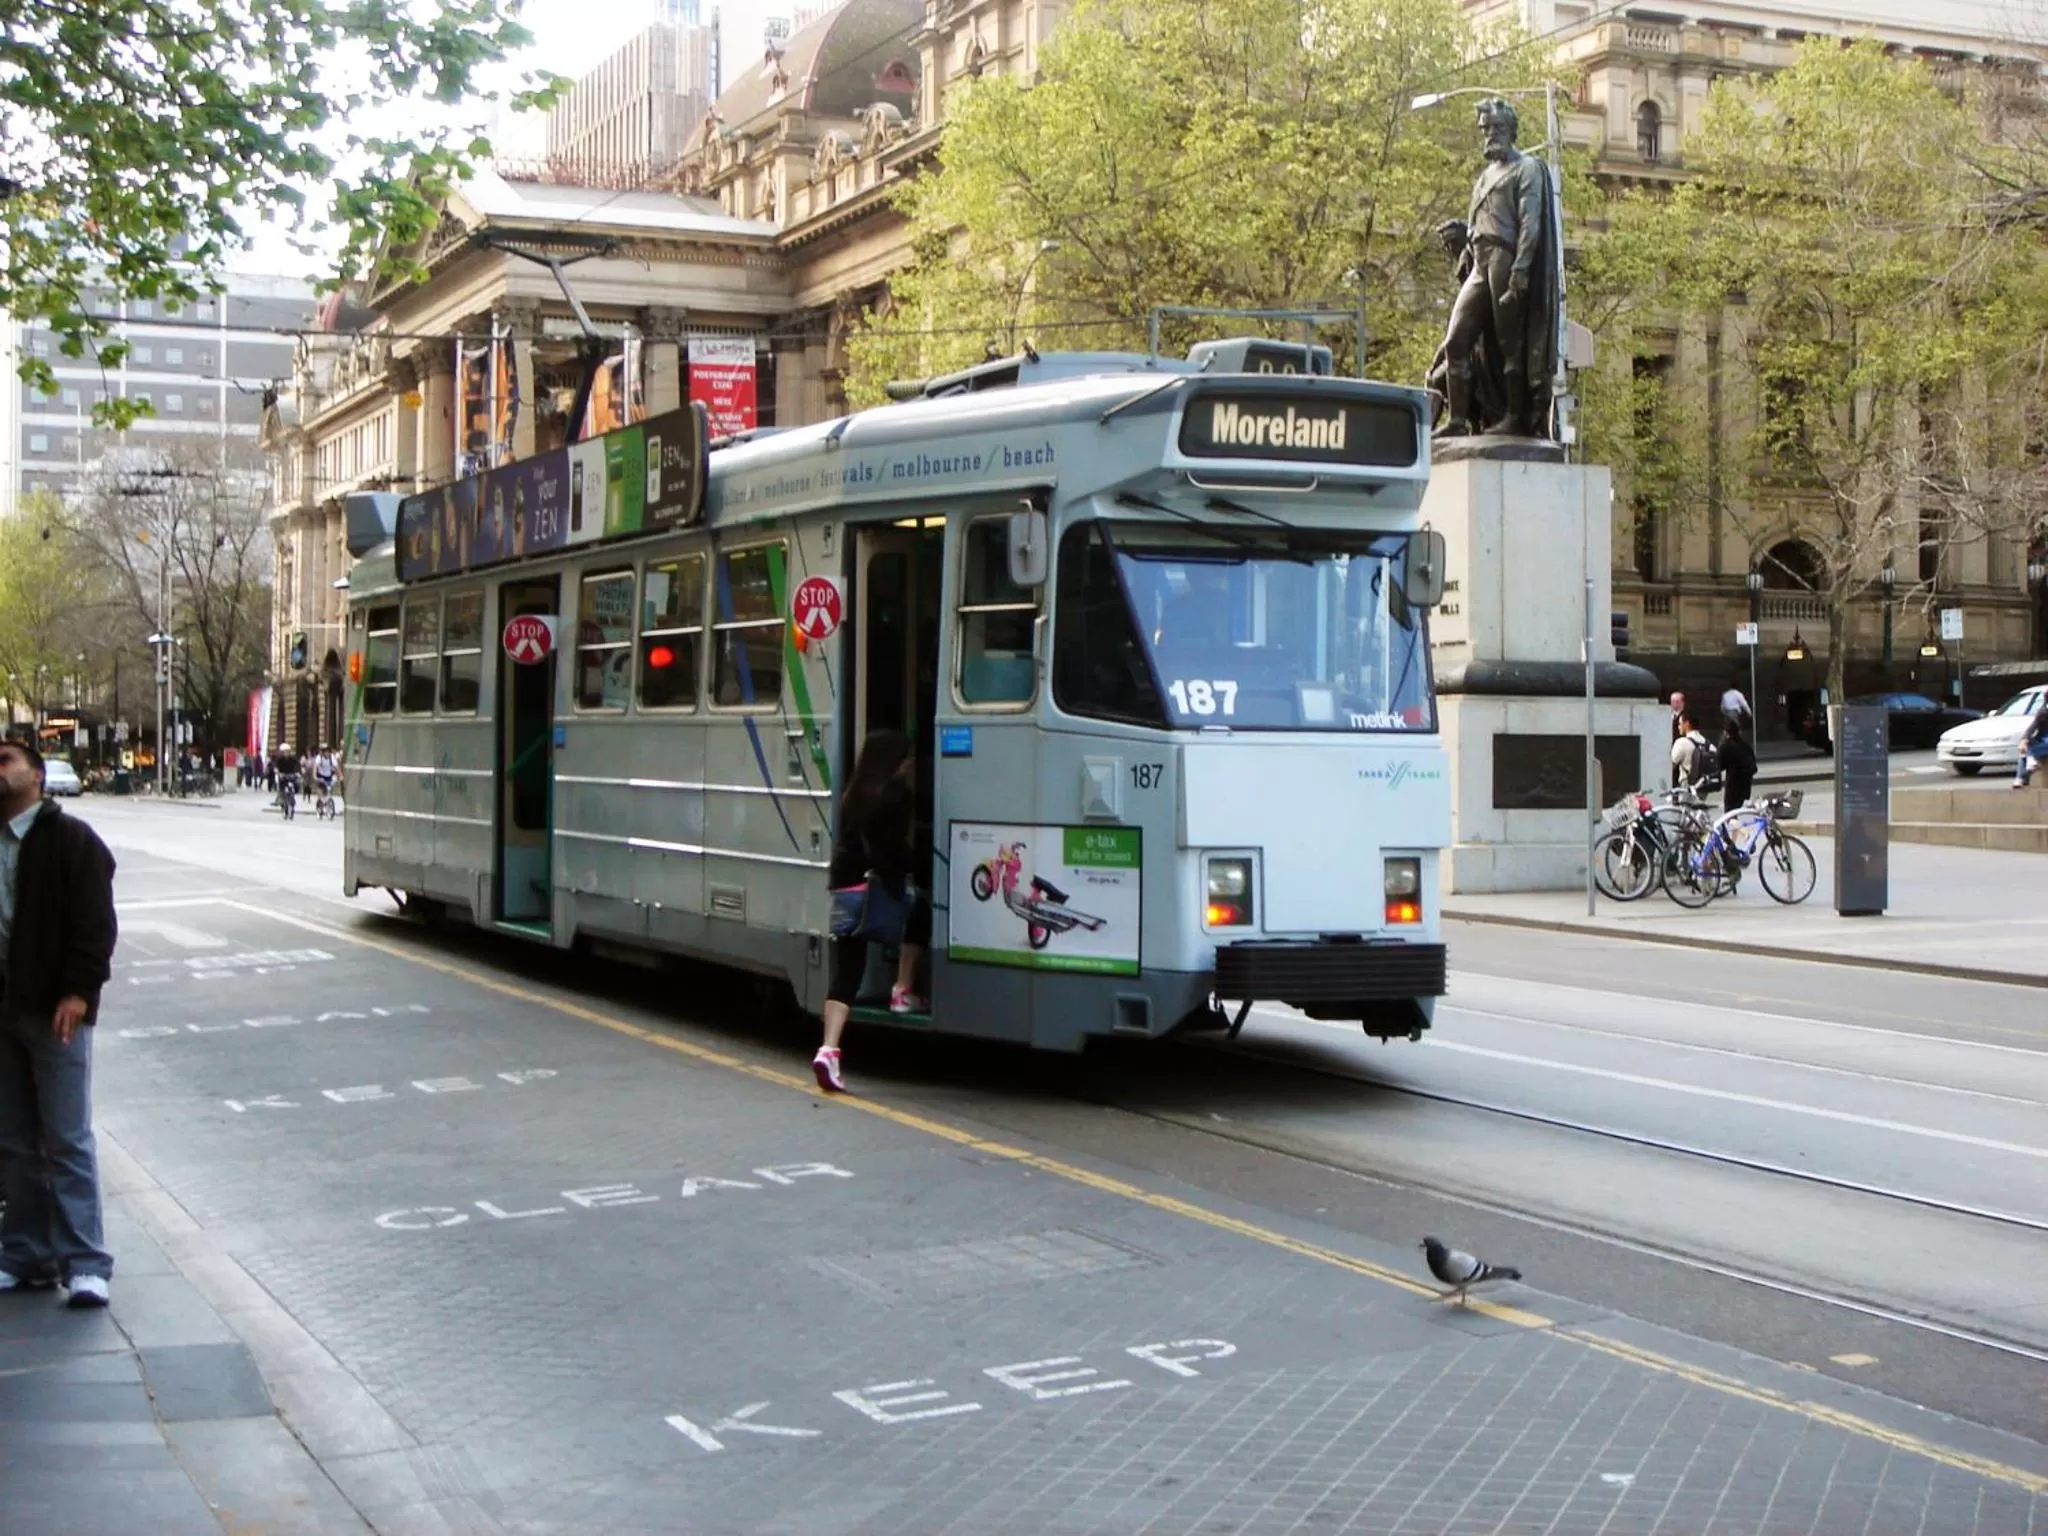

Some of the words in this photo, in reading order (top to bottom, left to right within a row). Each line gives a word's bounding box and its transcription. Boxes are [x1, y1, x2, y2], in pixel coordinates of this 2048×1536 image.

[1212, 403, 1346, 449] Moreland
[892, 454, 982, 478] melbourne
[1003, 442, 1055, 467] beach
[532, 507, 558, 542] ZEN
[800, 587, 834, 606] STOP
[511, 623, 544, 639] STOP
[1169, 679, 1238, 715] 187
[1350, 711, 1408, 729] metlink
[1130, 763, 1164, 789] 187
[223, 1068, 558, 1113] KEEP
[374, 1161, 856, 1231] CLEAR
[663, 1337, 1238, 1453] KEEP
